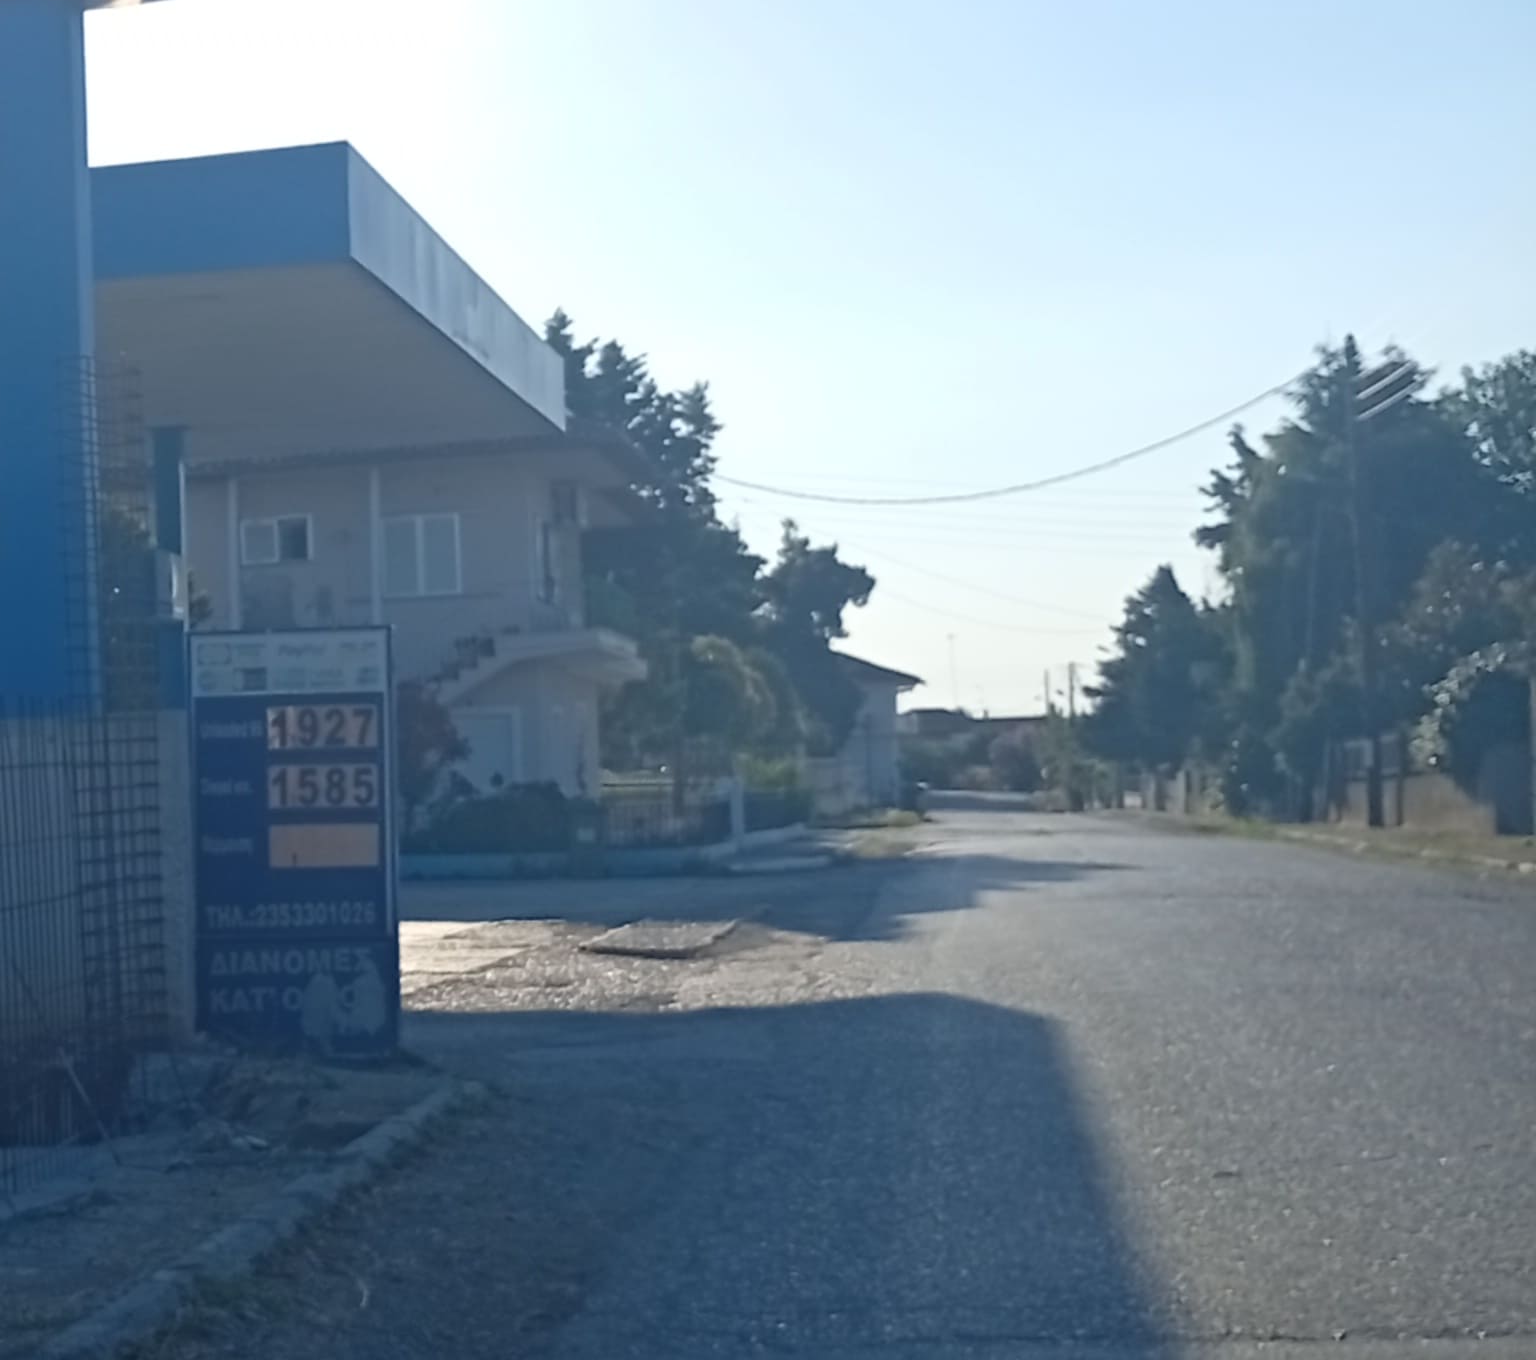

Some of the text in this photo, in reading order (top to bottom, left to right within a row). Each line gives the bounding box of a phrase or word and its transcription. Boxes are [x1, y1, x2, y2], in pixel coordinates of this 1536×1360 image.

[270, 708, 375, 748] 1927
[270, 767, 375, 807] 1585
[209, 947, 373, 976] ΔΙΑΝΟΜΕΣ
